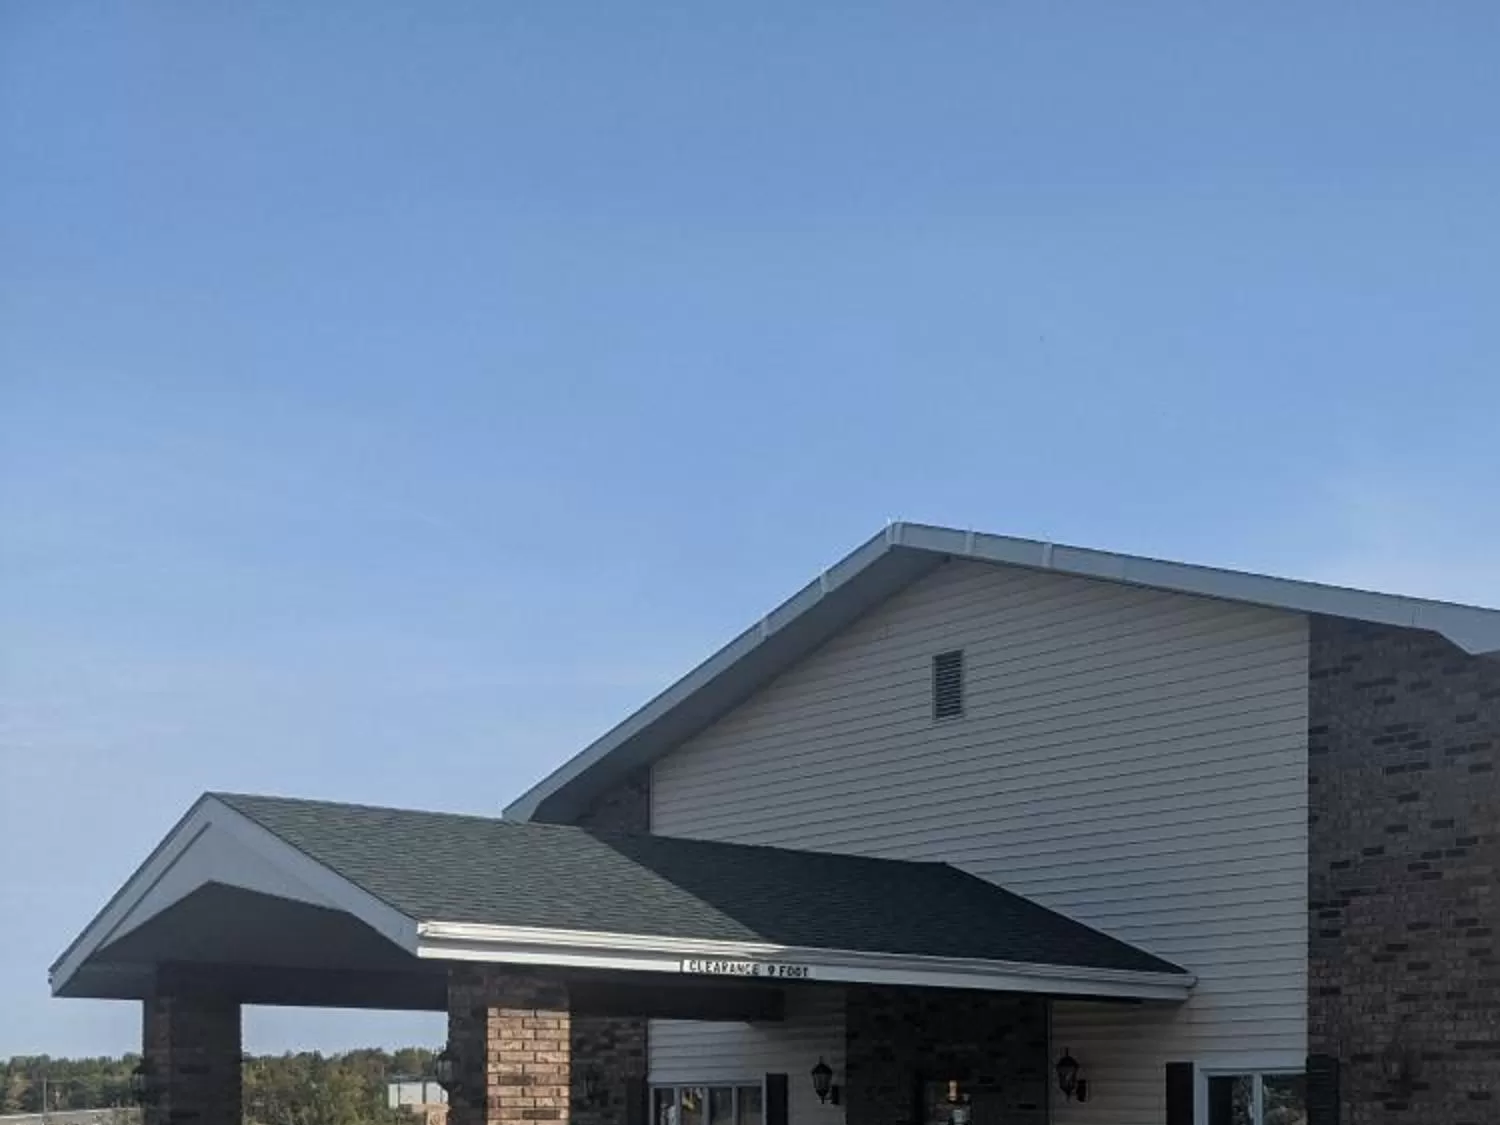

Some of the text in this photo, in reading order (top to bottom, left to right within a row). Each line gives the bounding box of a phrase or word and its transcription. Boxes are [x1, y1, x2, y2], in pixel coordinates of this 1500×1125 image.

[689, 960, 809, 977] CLEARANCE 9 FOOT
